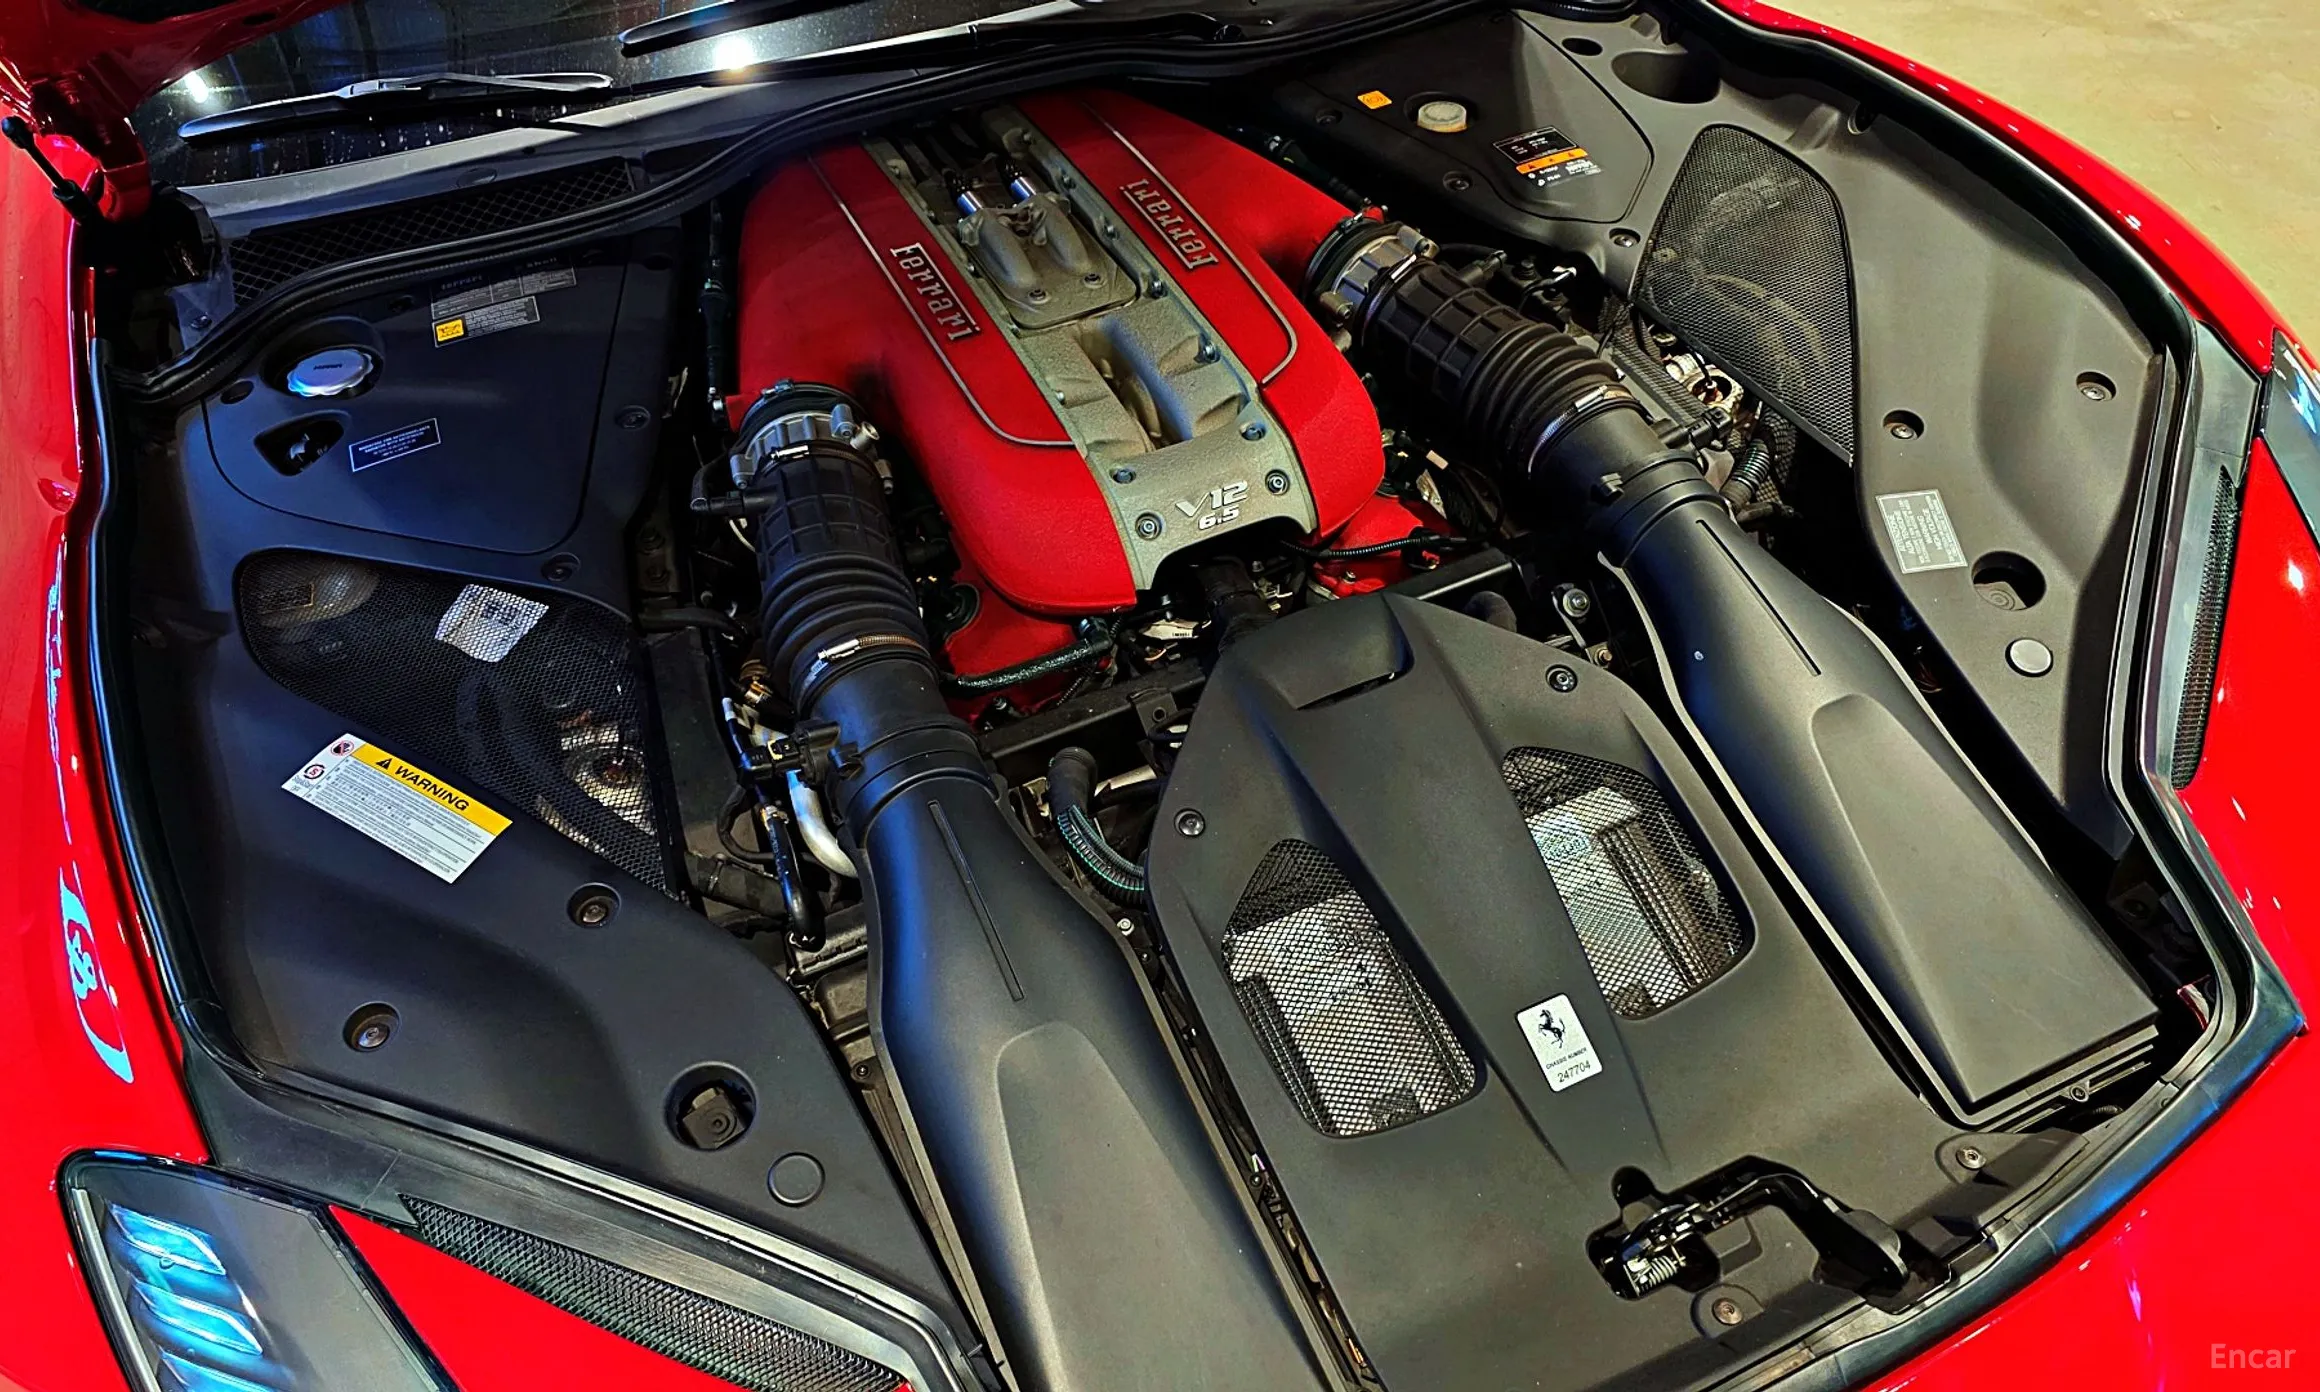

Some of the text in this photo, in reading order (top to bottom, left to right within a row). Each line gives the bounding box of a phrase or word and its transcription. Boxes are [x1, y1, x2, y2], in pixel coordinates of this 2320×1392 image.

[1119, 178, 1219, 270] Ferrari
[889, 242, 981, 341] Ferrari
[1175, 479, 1249, 518] V12
[1198, 504, 1240, 530] 6.5
[1916, 515, 1934, 544] WARNING
[395, 765, 469, 811] WARNING
[1557, 1060, 1591, 1083] 247704
